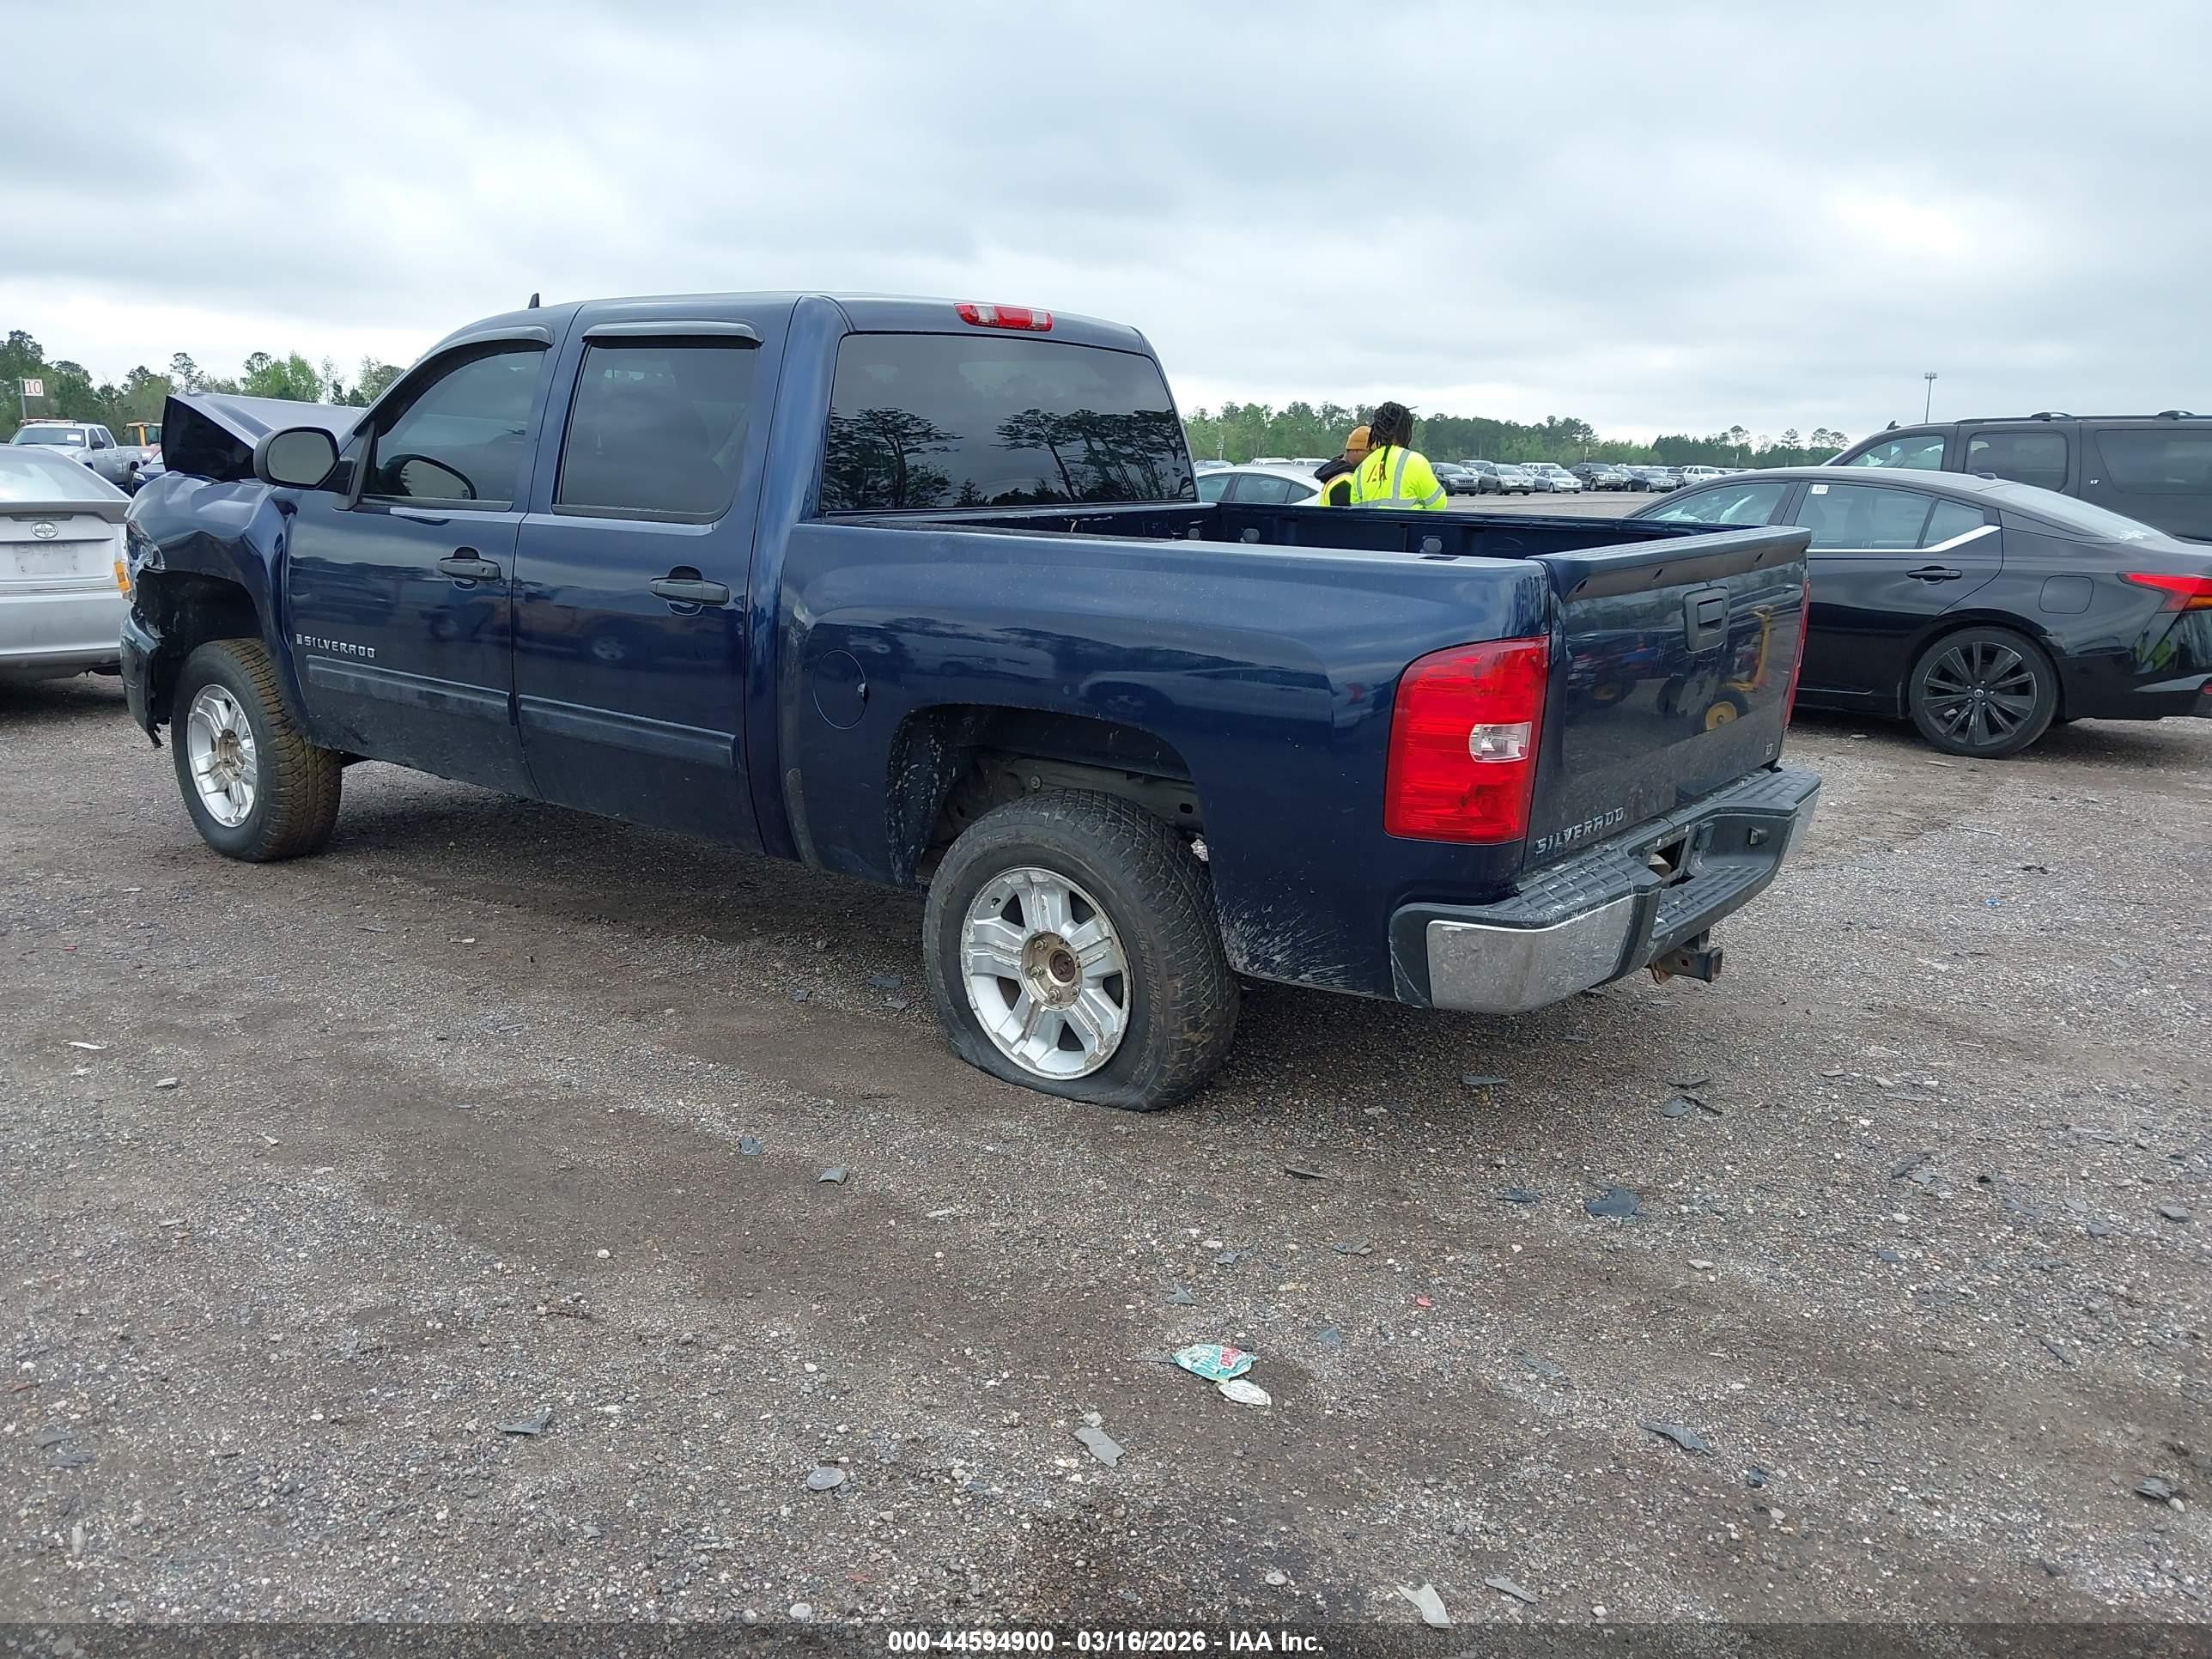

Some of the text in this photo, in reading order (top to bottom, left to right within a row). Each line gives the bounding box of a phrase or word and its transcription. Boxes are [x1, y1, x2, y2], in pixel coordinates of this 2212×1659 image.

[26, 380, 42, 394] 10
[304, 635, 375, 658] SILVERADO
[1534, 807, 1624, 855] SILVERADO
